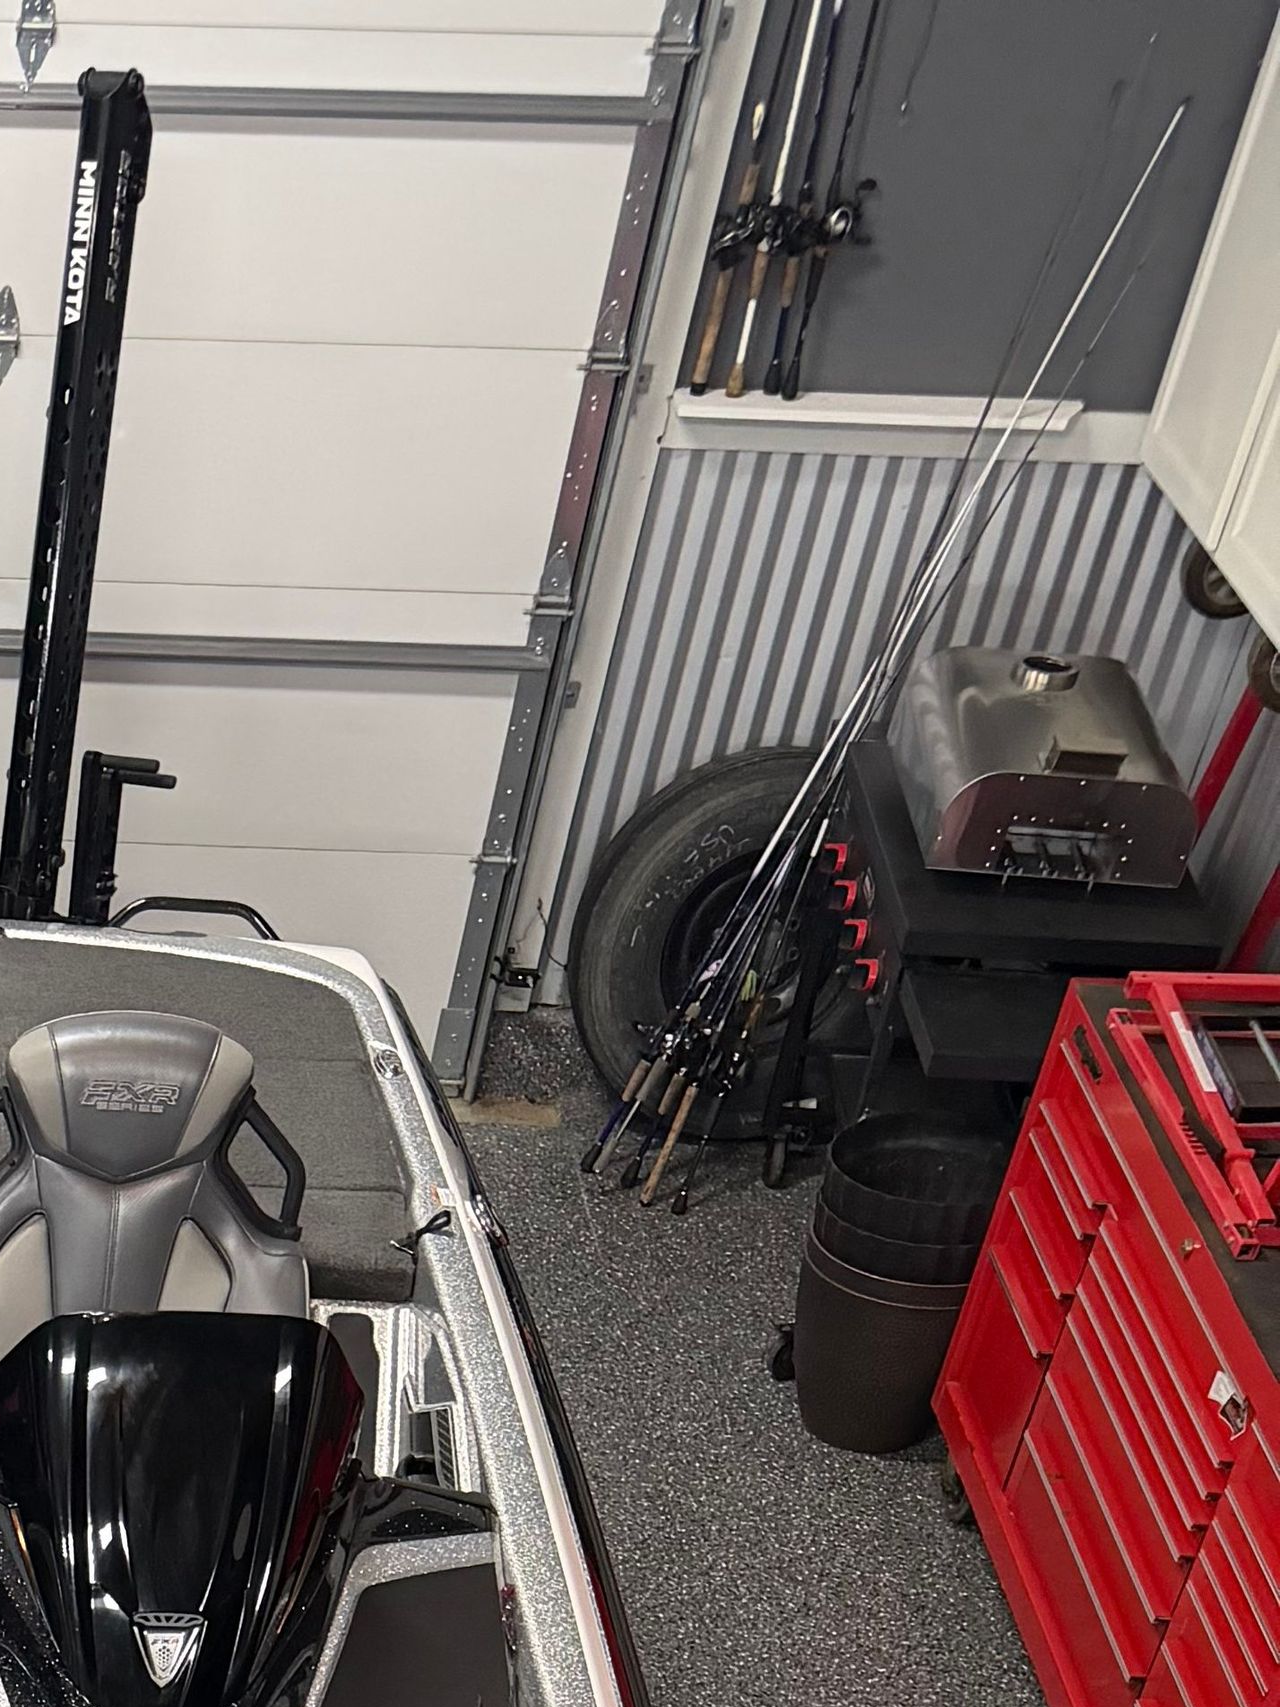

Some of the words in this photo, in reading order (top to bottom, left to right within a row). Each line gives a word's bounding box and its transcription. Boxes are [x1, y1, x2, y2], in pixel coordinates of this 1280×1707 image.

[73, 160, 98, 243] MINN
[64, 248, 88, 326] KOTA
[80, 1081, 180, 1105] FXR
